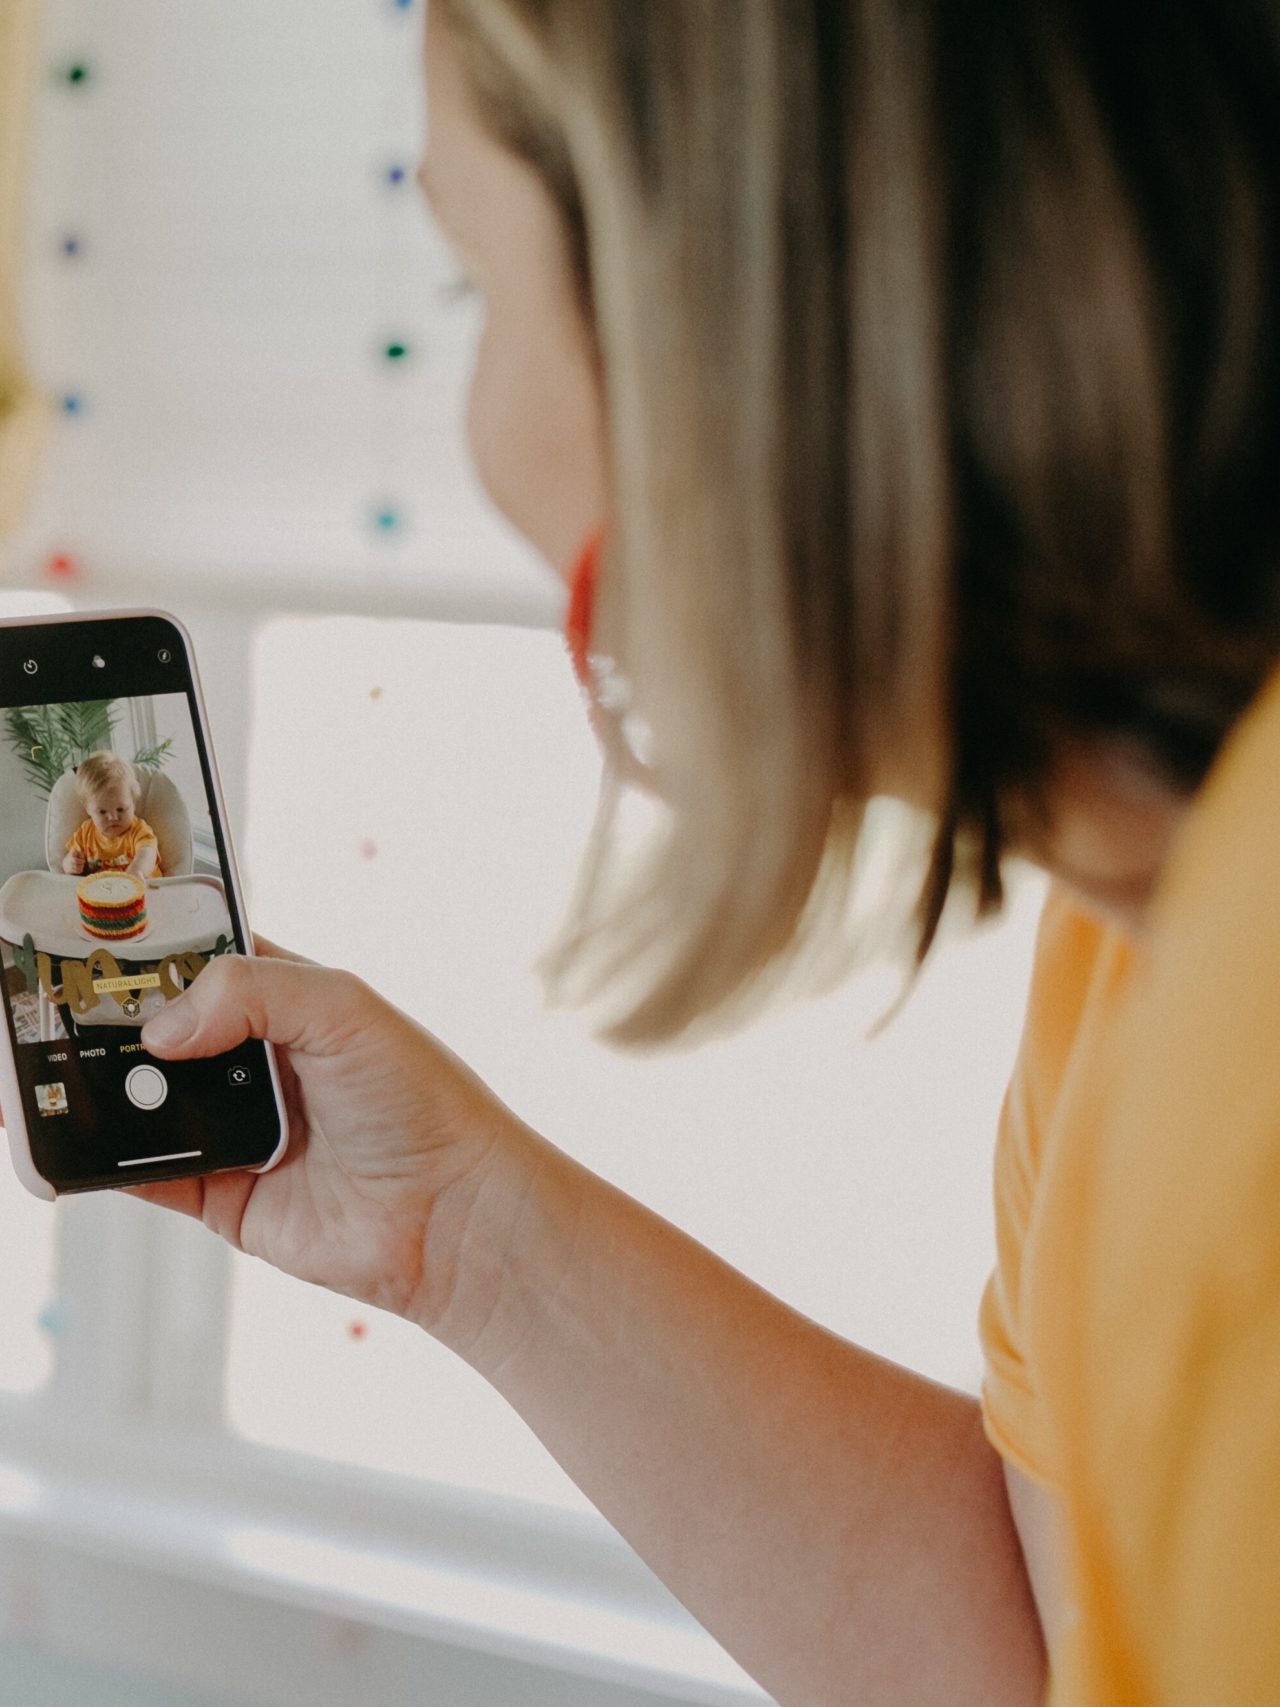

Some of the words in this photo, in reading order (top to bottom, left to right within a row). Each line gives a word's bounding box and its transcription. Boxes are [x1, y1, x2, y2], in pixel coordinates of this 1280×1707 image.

[97, 979, 132, 990] NATURAL
[134, 976, 156, 986] LIGHT
[48, 1052, 68, 1062] VIDEO
[80, 1048, 106, 1058] PHOTO
[120, 1043, 146, 1053] PORTR
